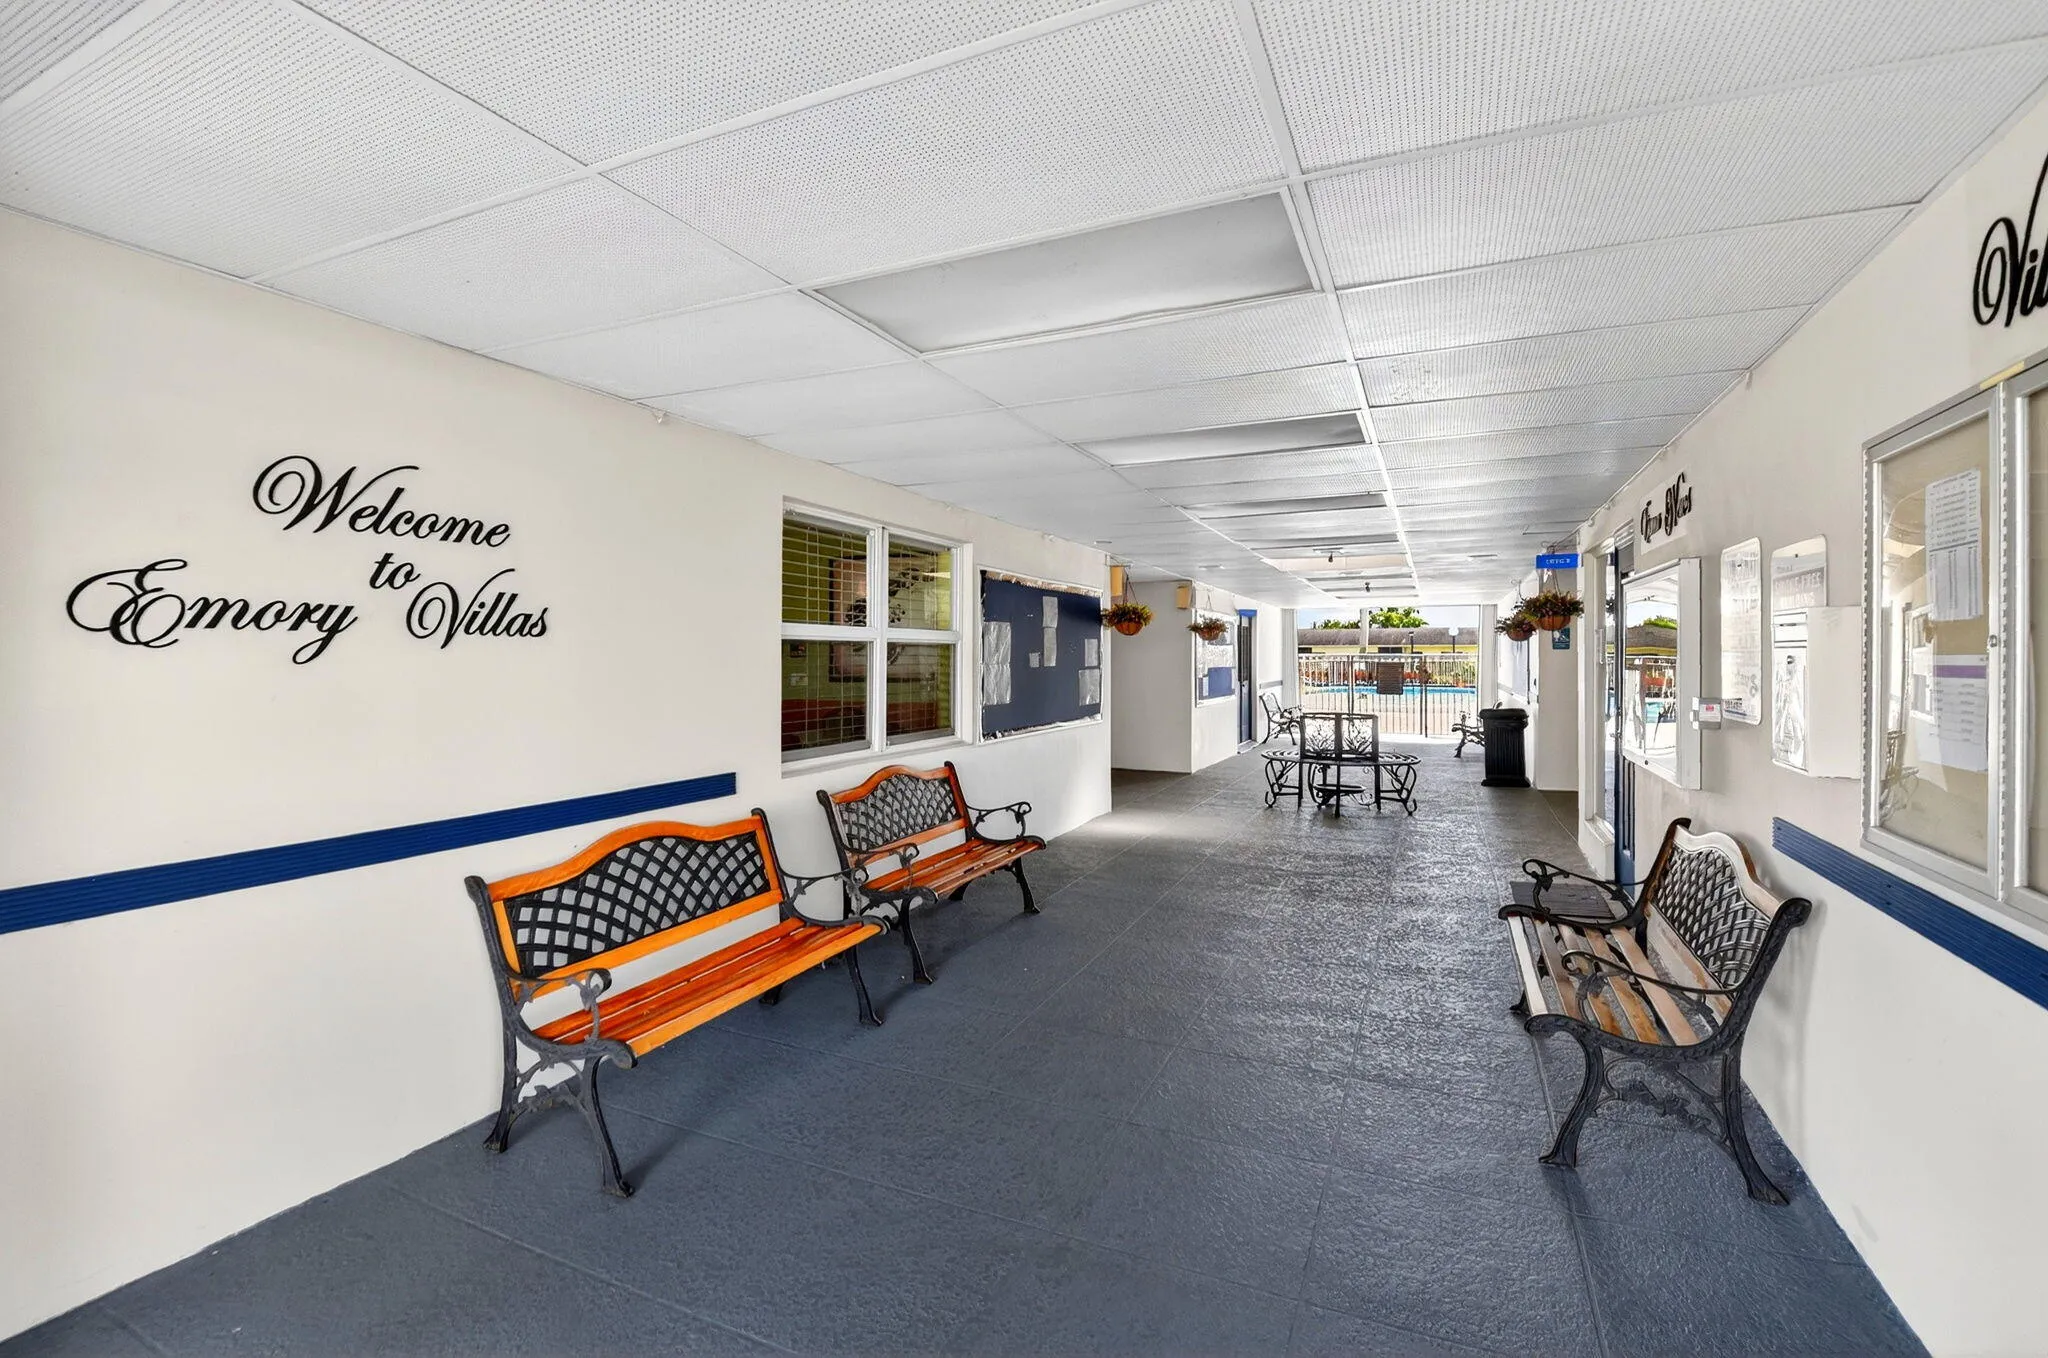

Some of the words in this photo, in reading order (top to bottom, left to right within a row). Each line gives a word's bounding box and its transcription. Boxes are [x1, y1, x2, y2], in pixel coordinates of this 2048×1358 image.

[252, 455, 511, 549] Welcome
[65, 558, 358, 665] Emory
[405, 568, 549, 650] Villas
[369, 552, 421, 591] to
